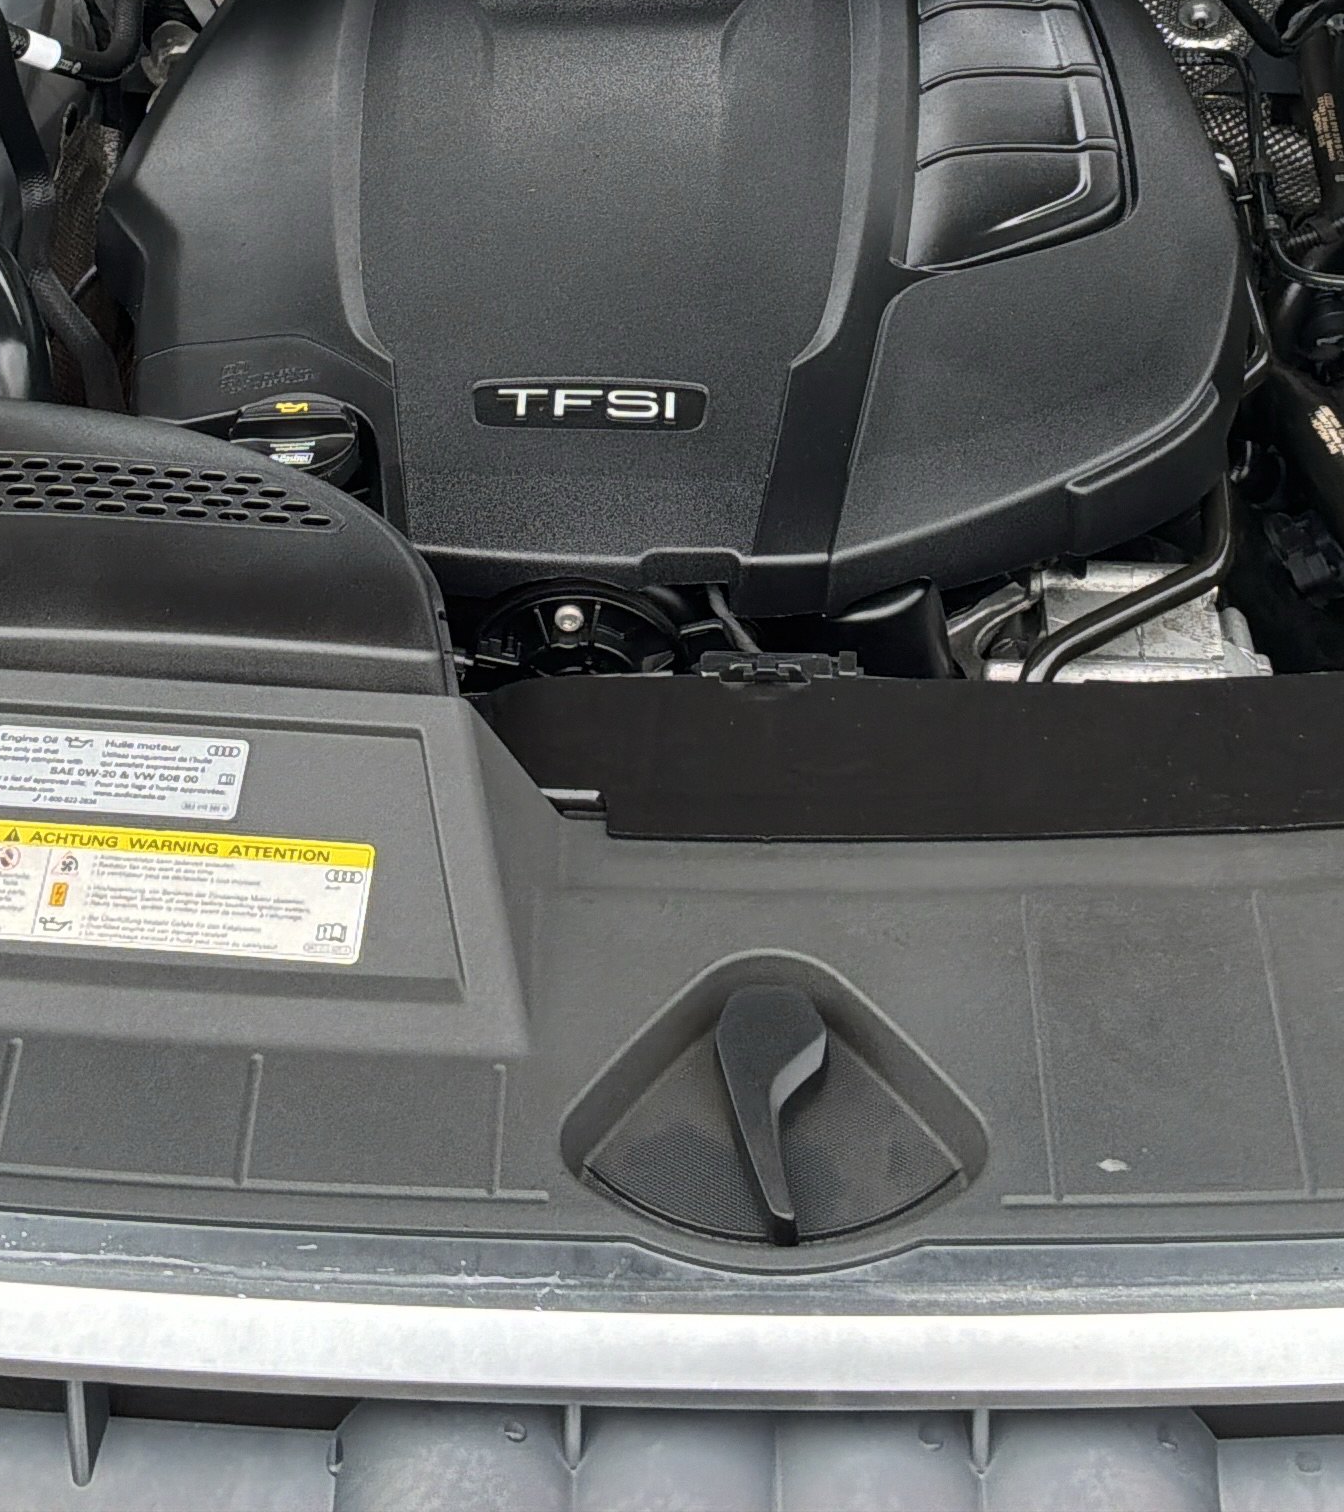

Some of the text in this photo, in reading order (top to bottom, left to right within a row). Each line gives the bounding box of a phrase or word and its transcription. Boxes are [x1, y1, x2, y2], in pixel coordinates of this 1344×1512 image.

[497, 388, 676, 420] TFSI
[0, 732, 59, 744] Engine Oil
[105, 739, 181, 752] Huile moteur
[49, 767, 75, 776] SAE
[77, 768, 117, 778] 0W-20
[120, 771, 130, 780] &
[134, 771, 157, 781] VW
[183, 775, 199, 784] 00
[29, 830, 119, 849] ACHTUNG
[129, 837, 219, 855] WARNING
[228, 844, 331, 863] ATTENTION
